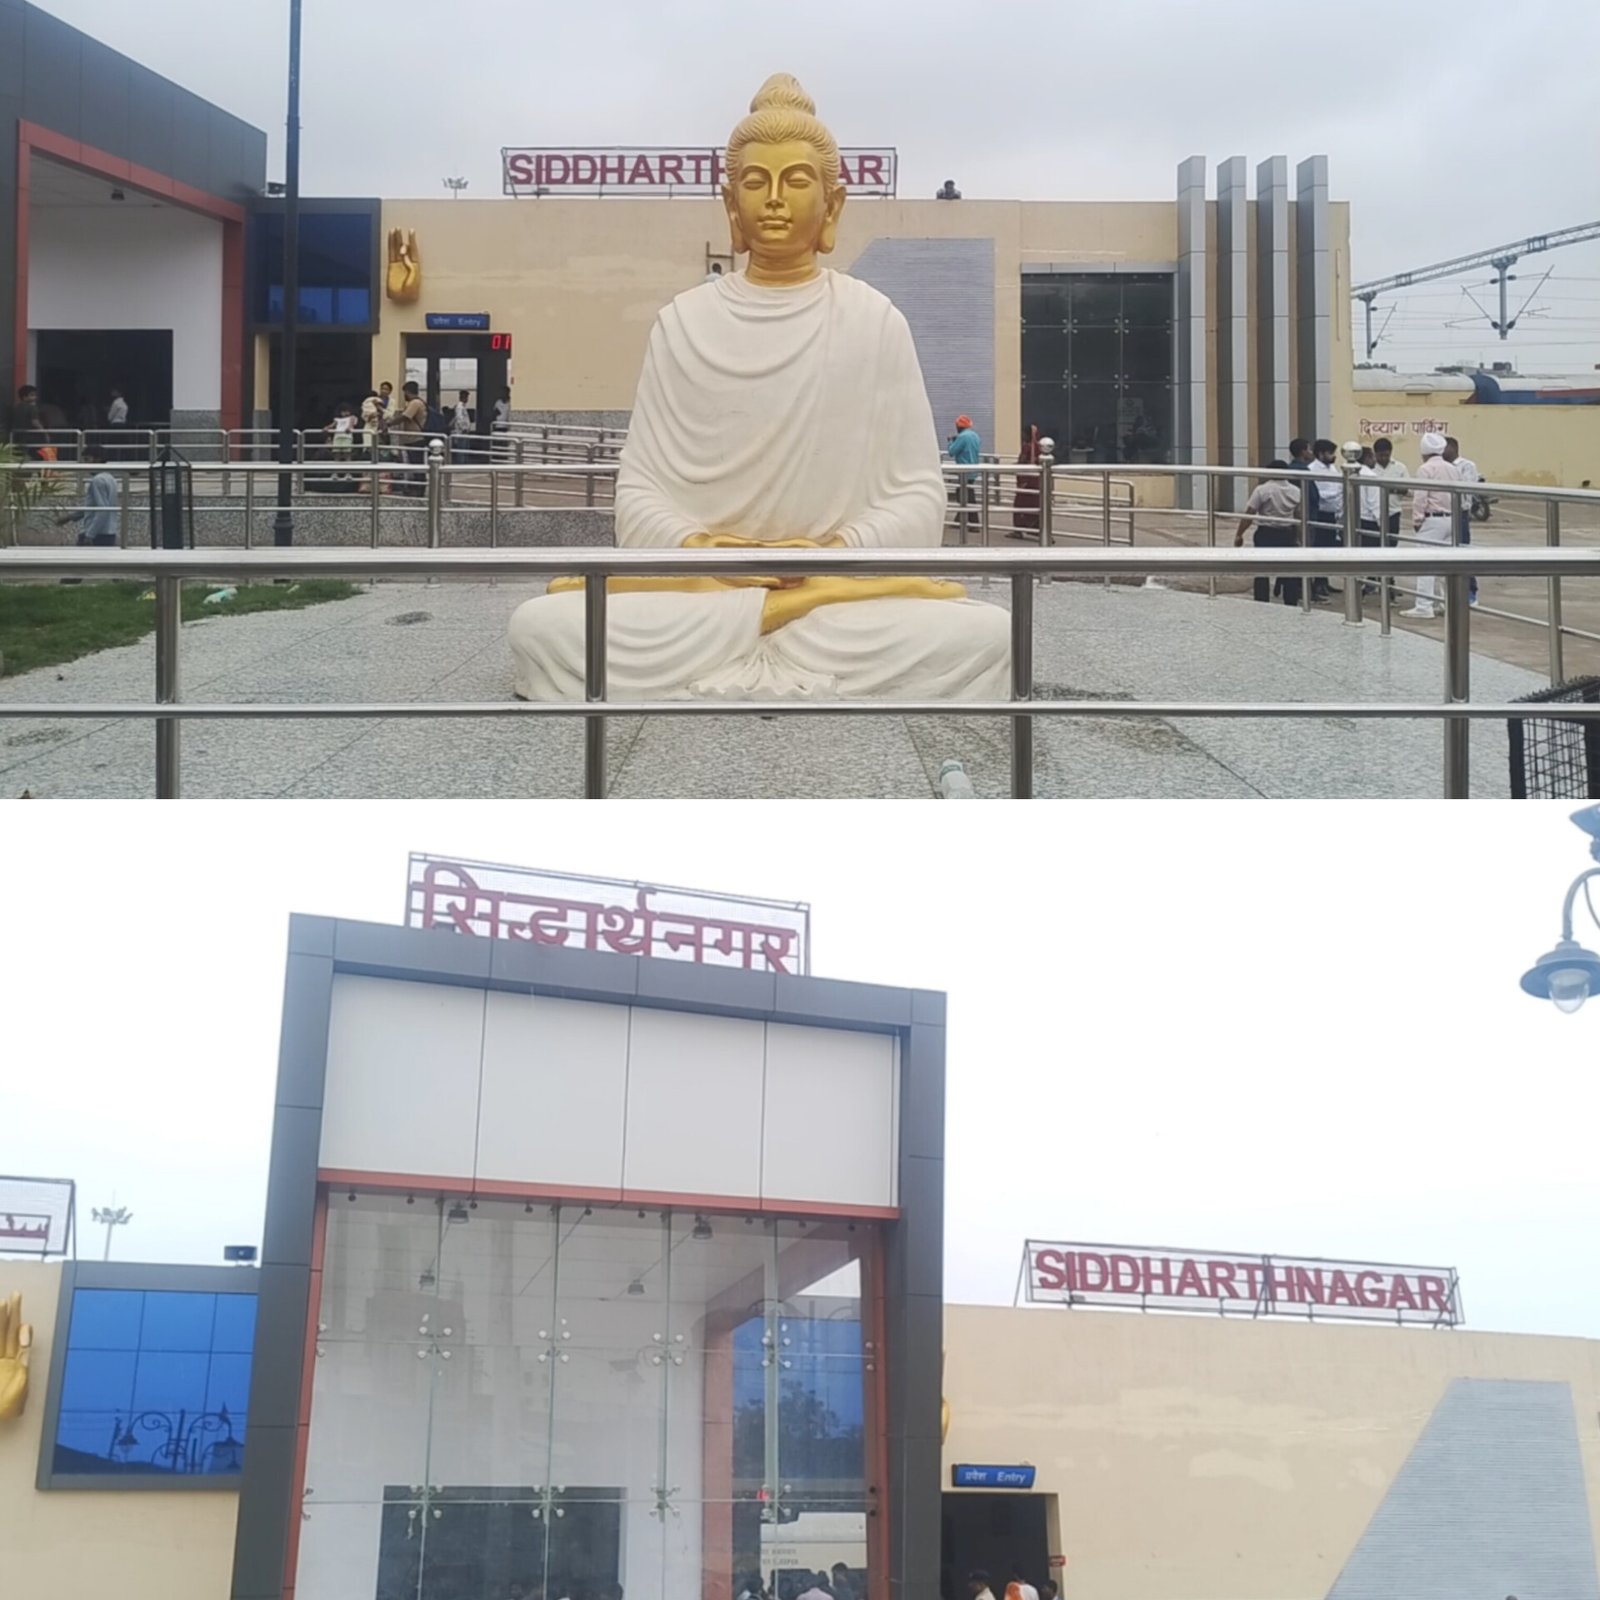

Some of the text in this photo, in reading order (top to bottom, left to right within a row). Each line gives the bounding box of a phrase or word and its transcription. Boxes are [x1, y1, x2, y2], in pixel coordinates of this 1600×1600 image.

[457, 317, 481, 328] Entry
[1035, 1249, 1452, 1311] SIDDHARTHNAGAR
[996, 1471, 1027, 1484] Entry
